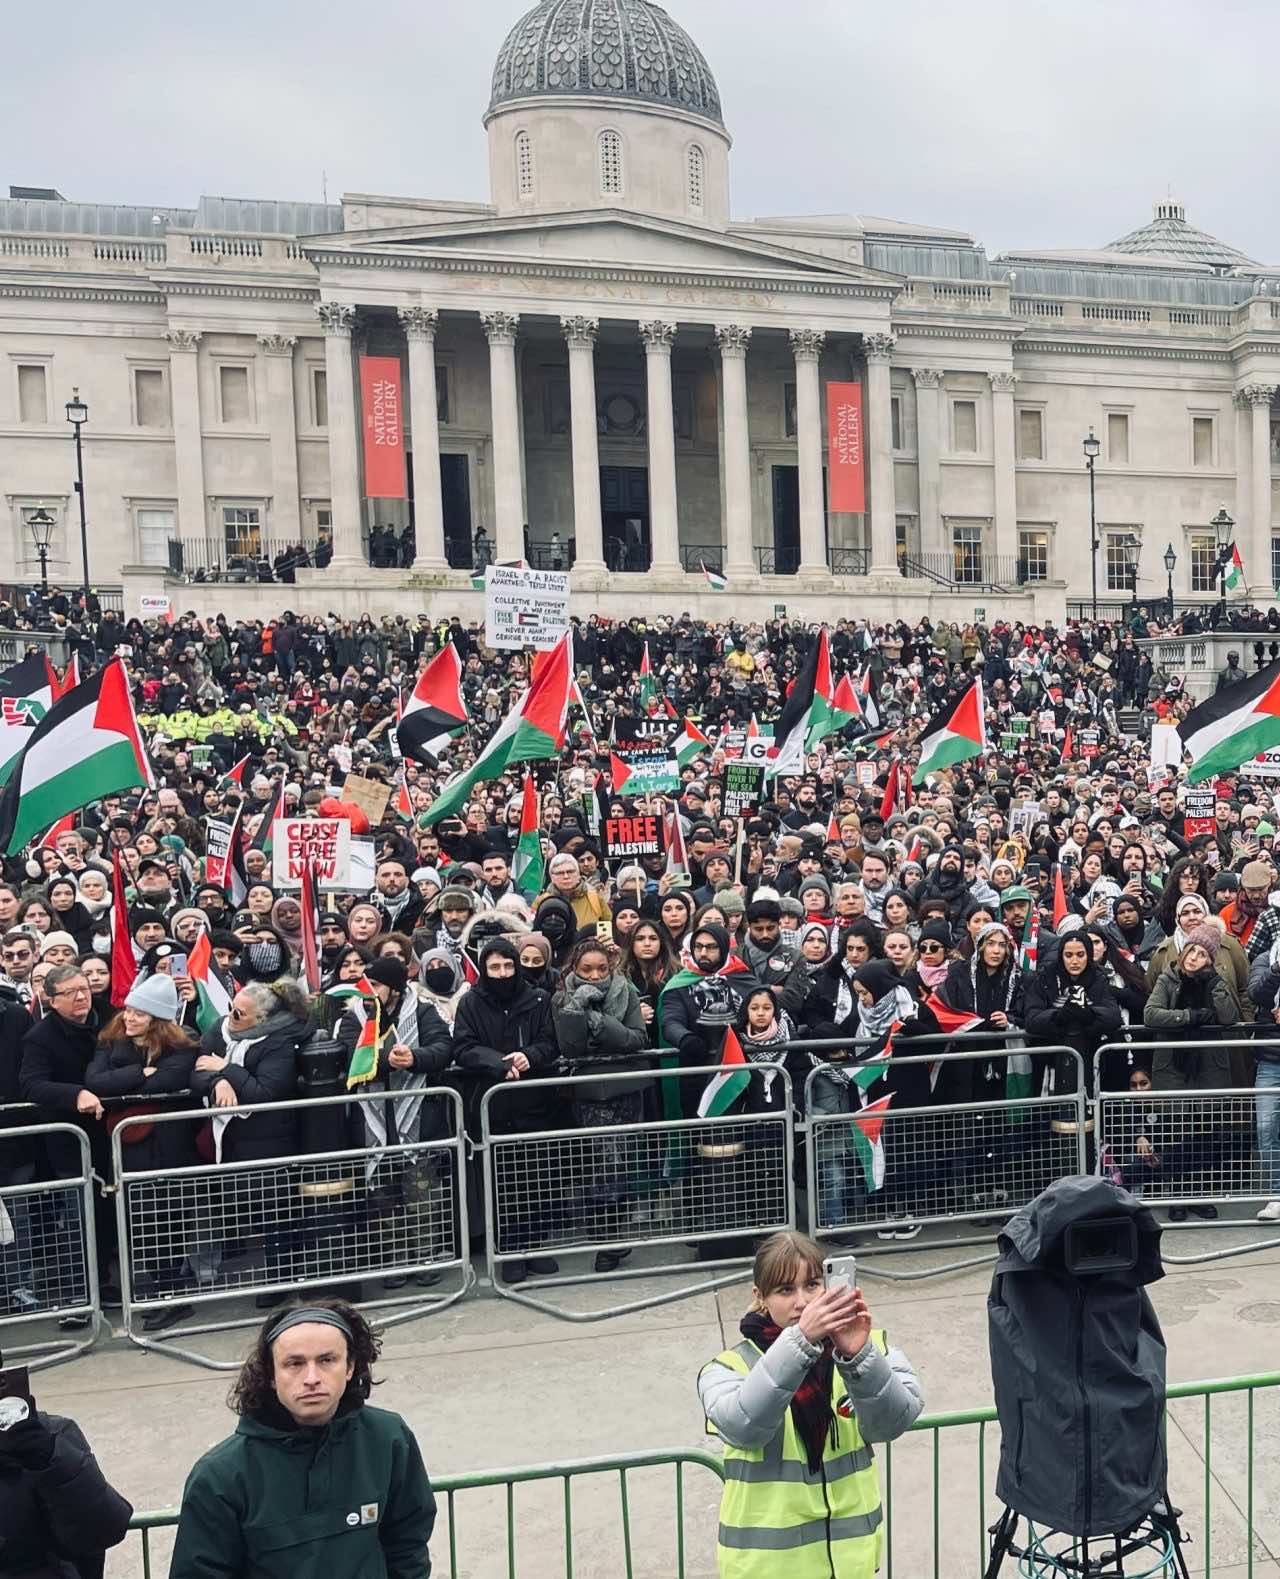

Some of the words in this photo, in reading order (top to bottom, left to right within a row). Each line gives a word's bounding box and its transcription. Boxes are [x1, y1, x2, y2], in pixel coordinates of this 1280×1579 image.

[373, 379, 386, 446] NATIONAL
[385, 380, 399, 447] GALLERY
[837, 403, 849, 465] NATIONAL
[848, 404, 860, 465] GALLERY
[495, 569, 519, 579] ISRAEL
[727, 765, 747, 776] FROM
[748, 767, 760, 776] THE
[727, 775, 747, 783] RIVER
[748, 775, 757, 783] TO
[727, 782, 738, 791] THE
[740, 784, 753, 792] SEA
[725, 790, 759, 800] PALESTINE
[725, 799, 740, 808] WILL
[742, 800, 751, 808] BE
[1186, 796, 1214, 806] FREEDOM
[723, 807, 740, 816] FREE
[1185, 808, 1215, 818] PALESTINE
[287, 823, 339, 841] CEASE
[606, 817, 657, 843] FREE
[288, 841, 337, 860] FIRE
[607, 841, 659, 856] PALESTINE
